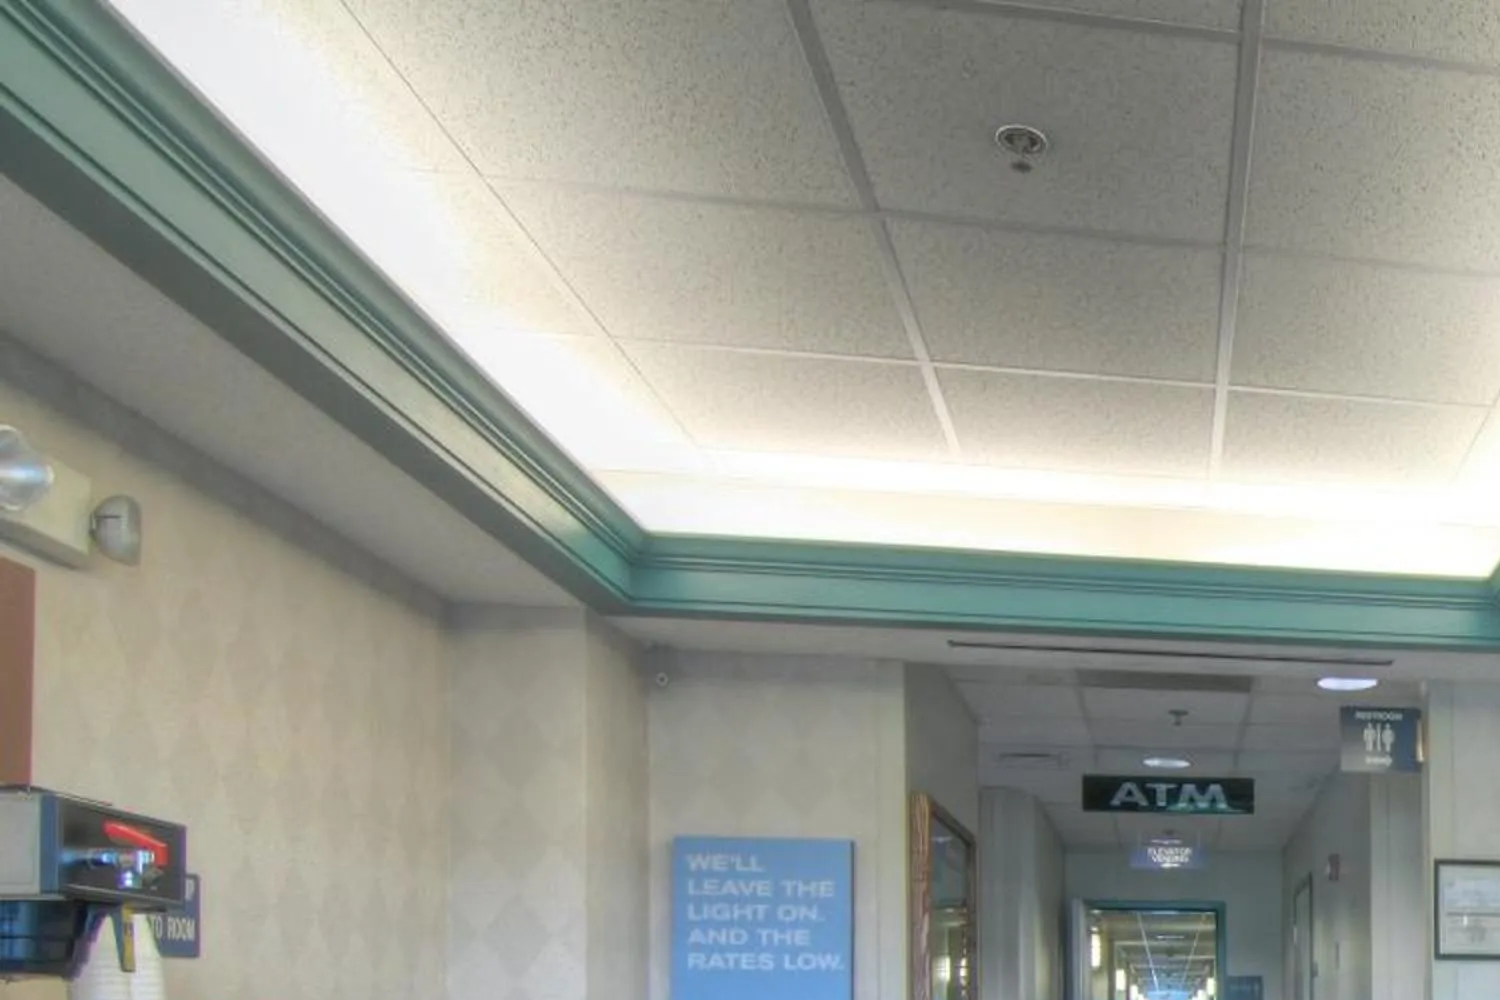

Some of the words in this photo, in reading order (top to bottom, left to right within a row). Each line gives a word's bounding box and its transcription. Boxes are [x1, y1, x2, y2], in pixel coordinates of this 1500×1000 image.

[1110, 782, 1228, 808] ATM
[686, 854, 765, 872] WE'LL
[687, 879, 772, 896] LEAVE
[781, 880, 835, 897] THE
[687, 904, 771, 921] LIGHT
[687, 928, 748, 945] AND
[757, 929, 812, 946] THE
[687, 952, 774, 970] RATES
[784, 953, 845, 970] LOW.
